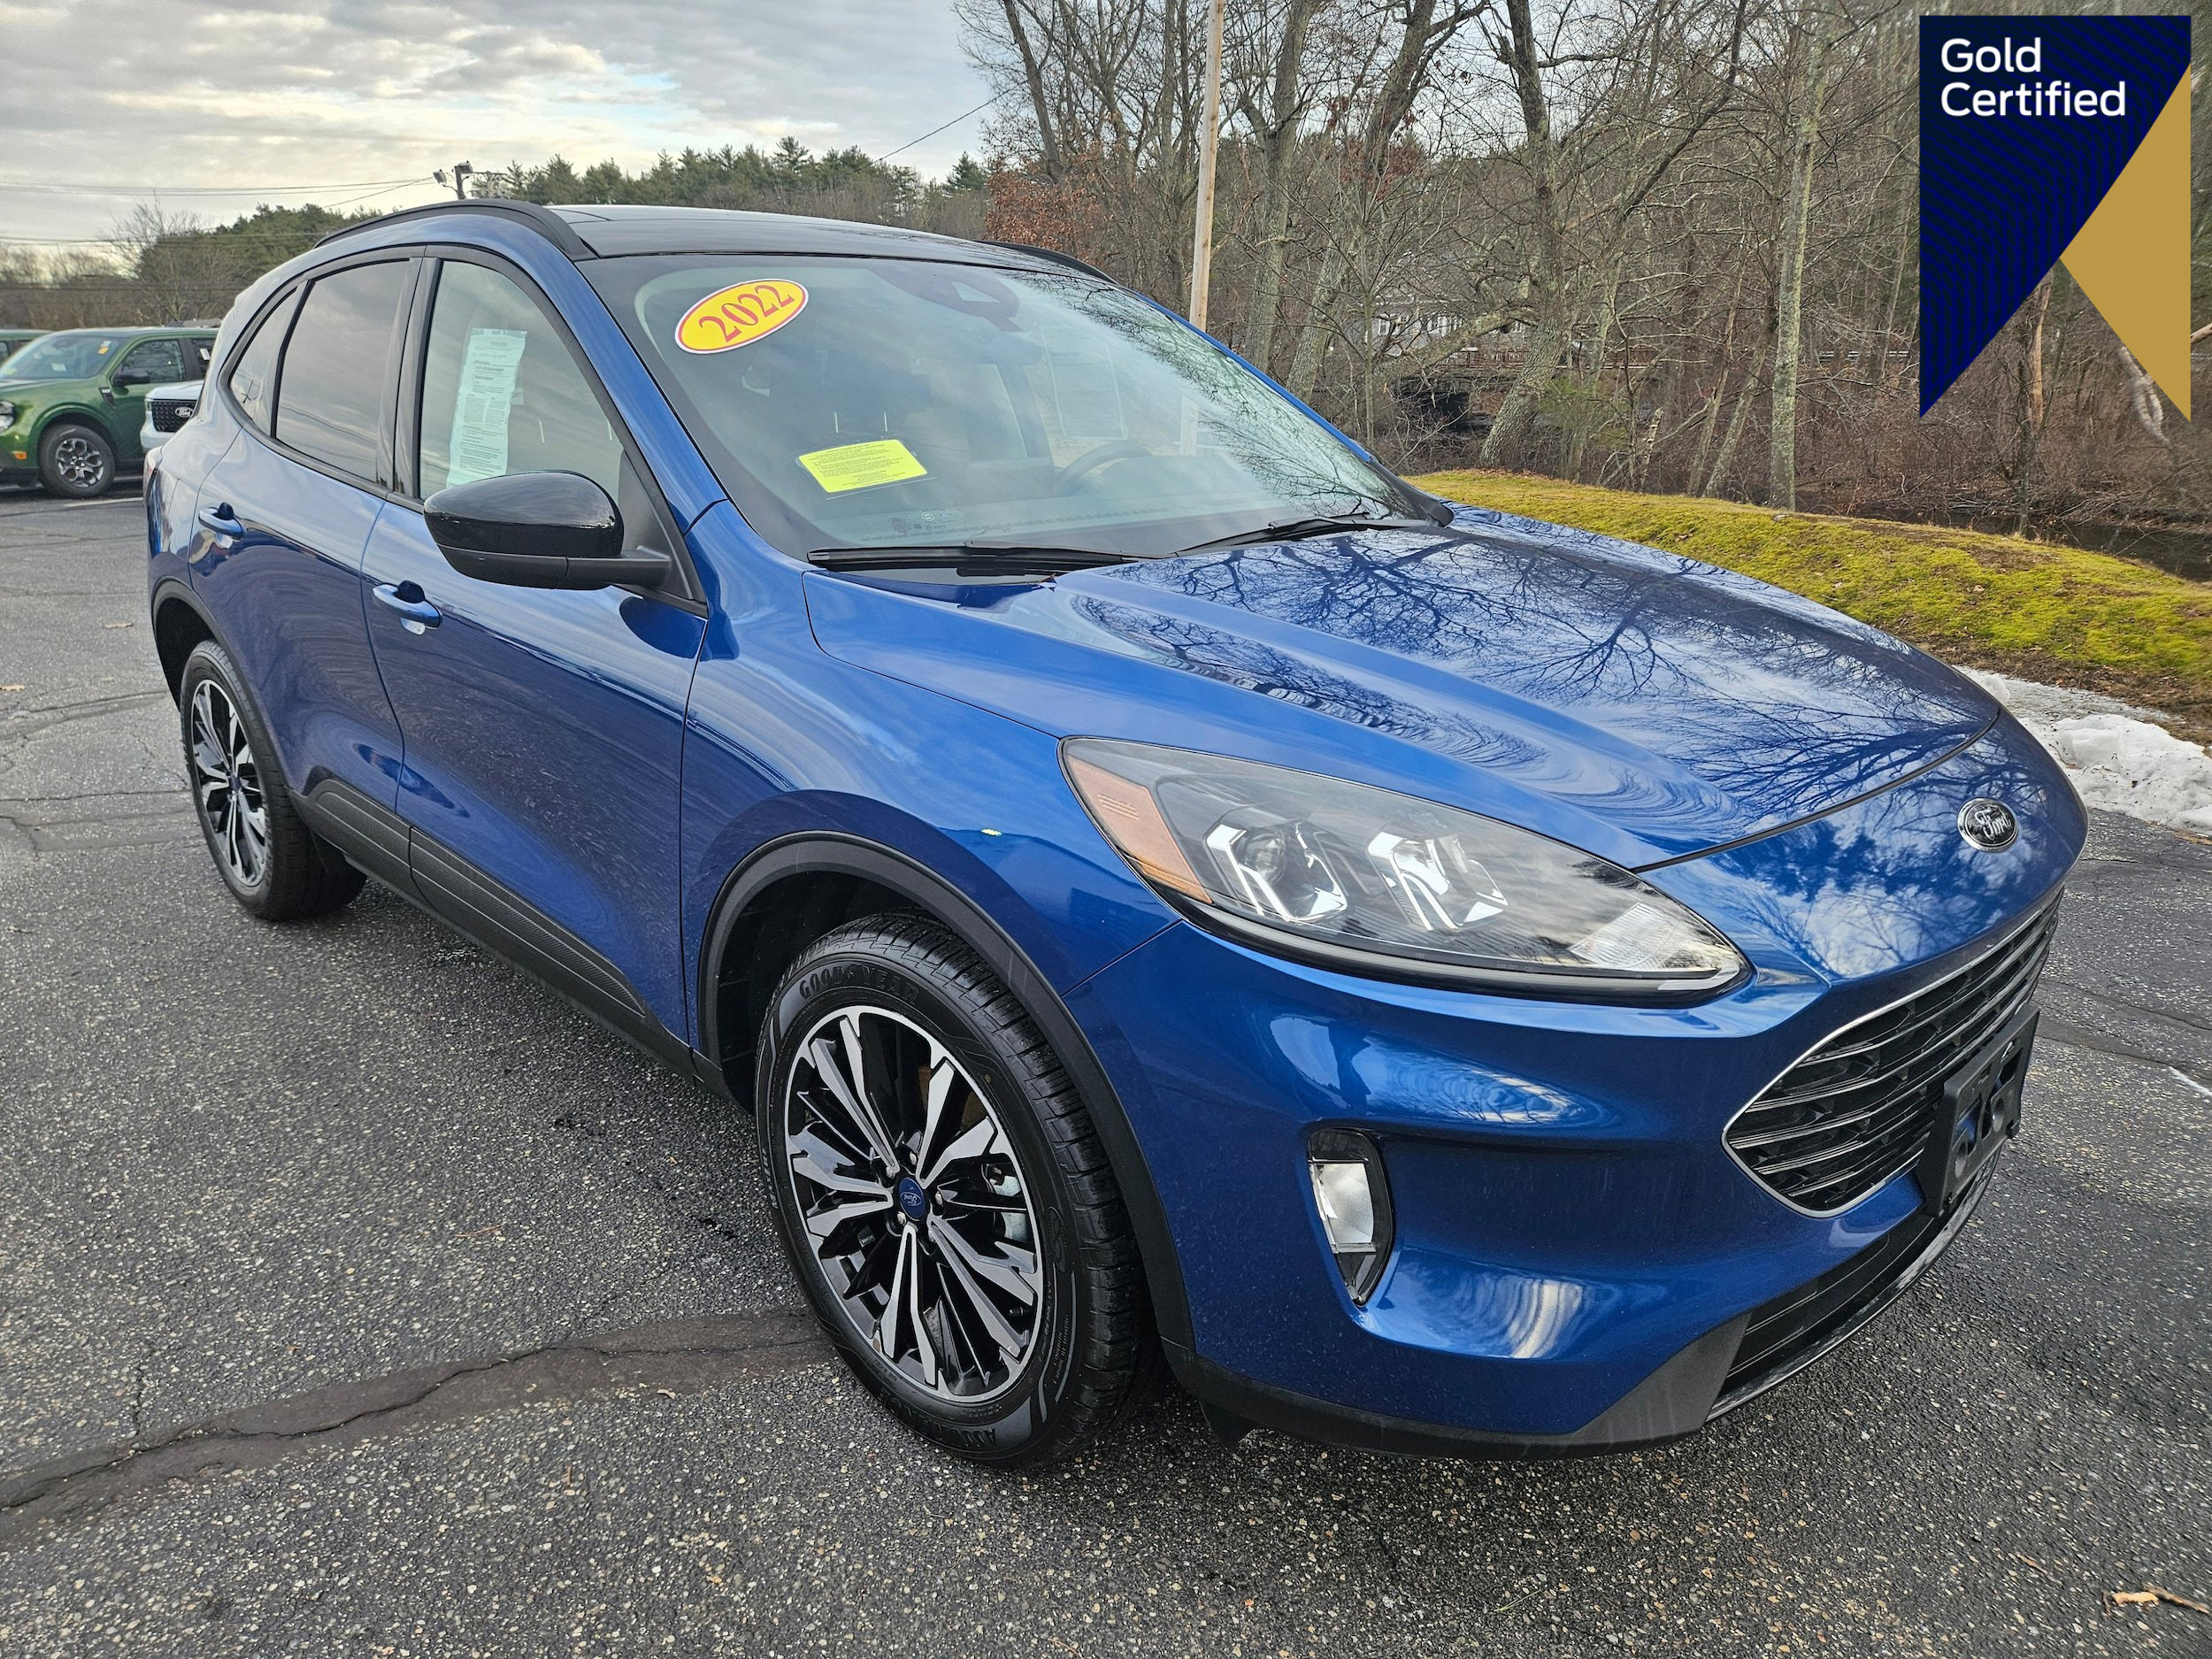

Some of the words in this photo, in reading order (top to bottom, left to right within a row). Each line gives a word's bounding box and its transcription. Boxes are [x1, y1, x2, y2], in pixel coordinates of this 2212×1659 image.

[698, 284, 795, 342] 2022
[1974, 805, 2012, 841] Ford
[799, 963, 919, 1006] GOODYEAR
[903, 1194, 918, 1205] Ford
